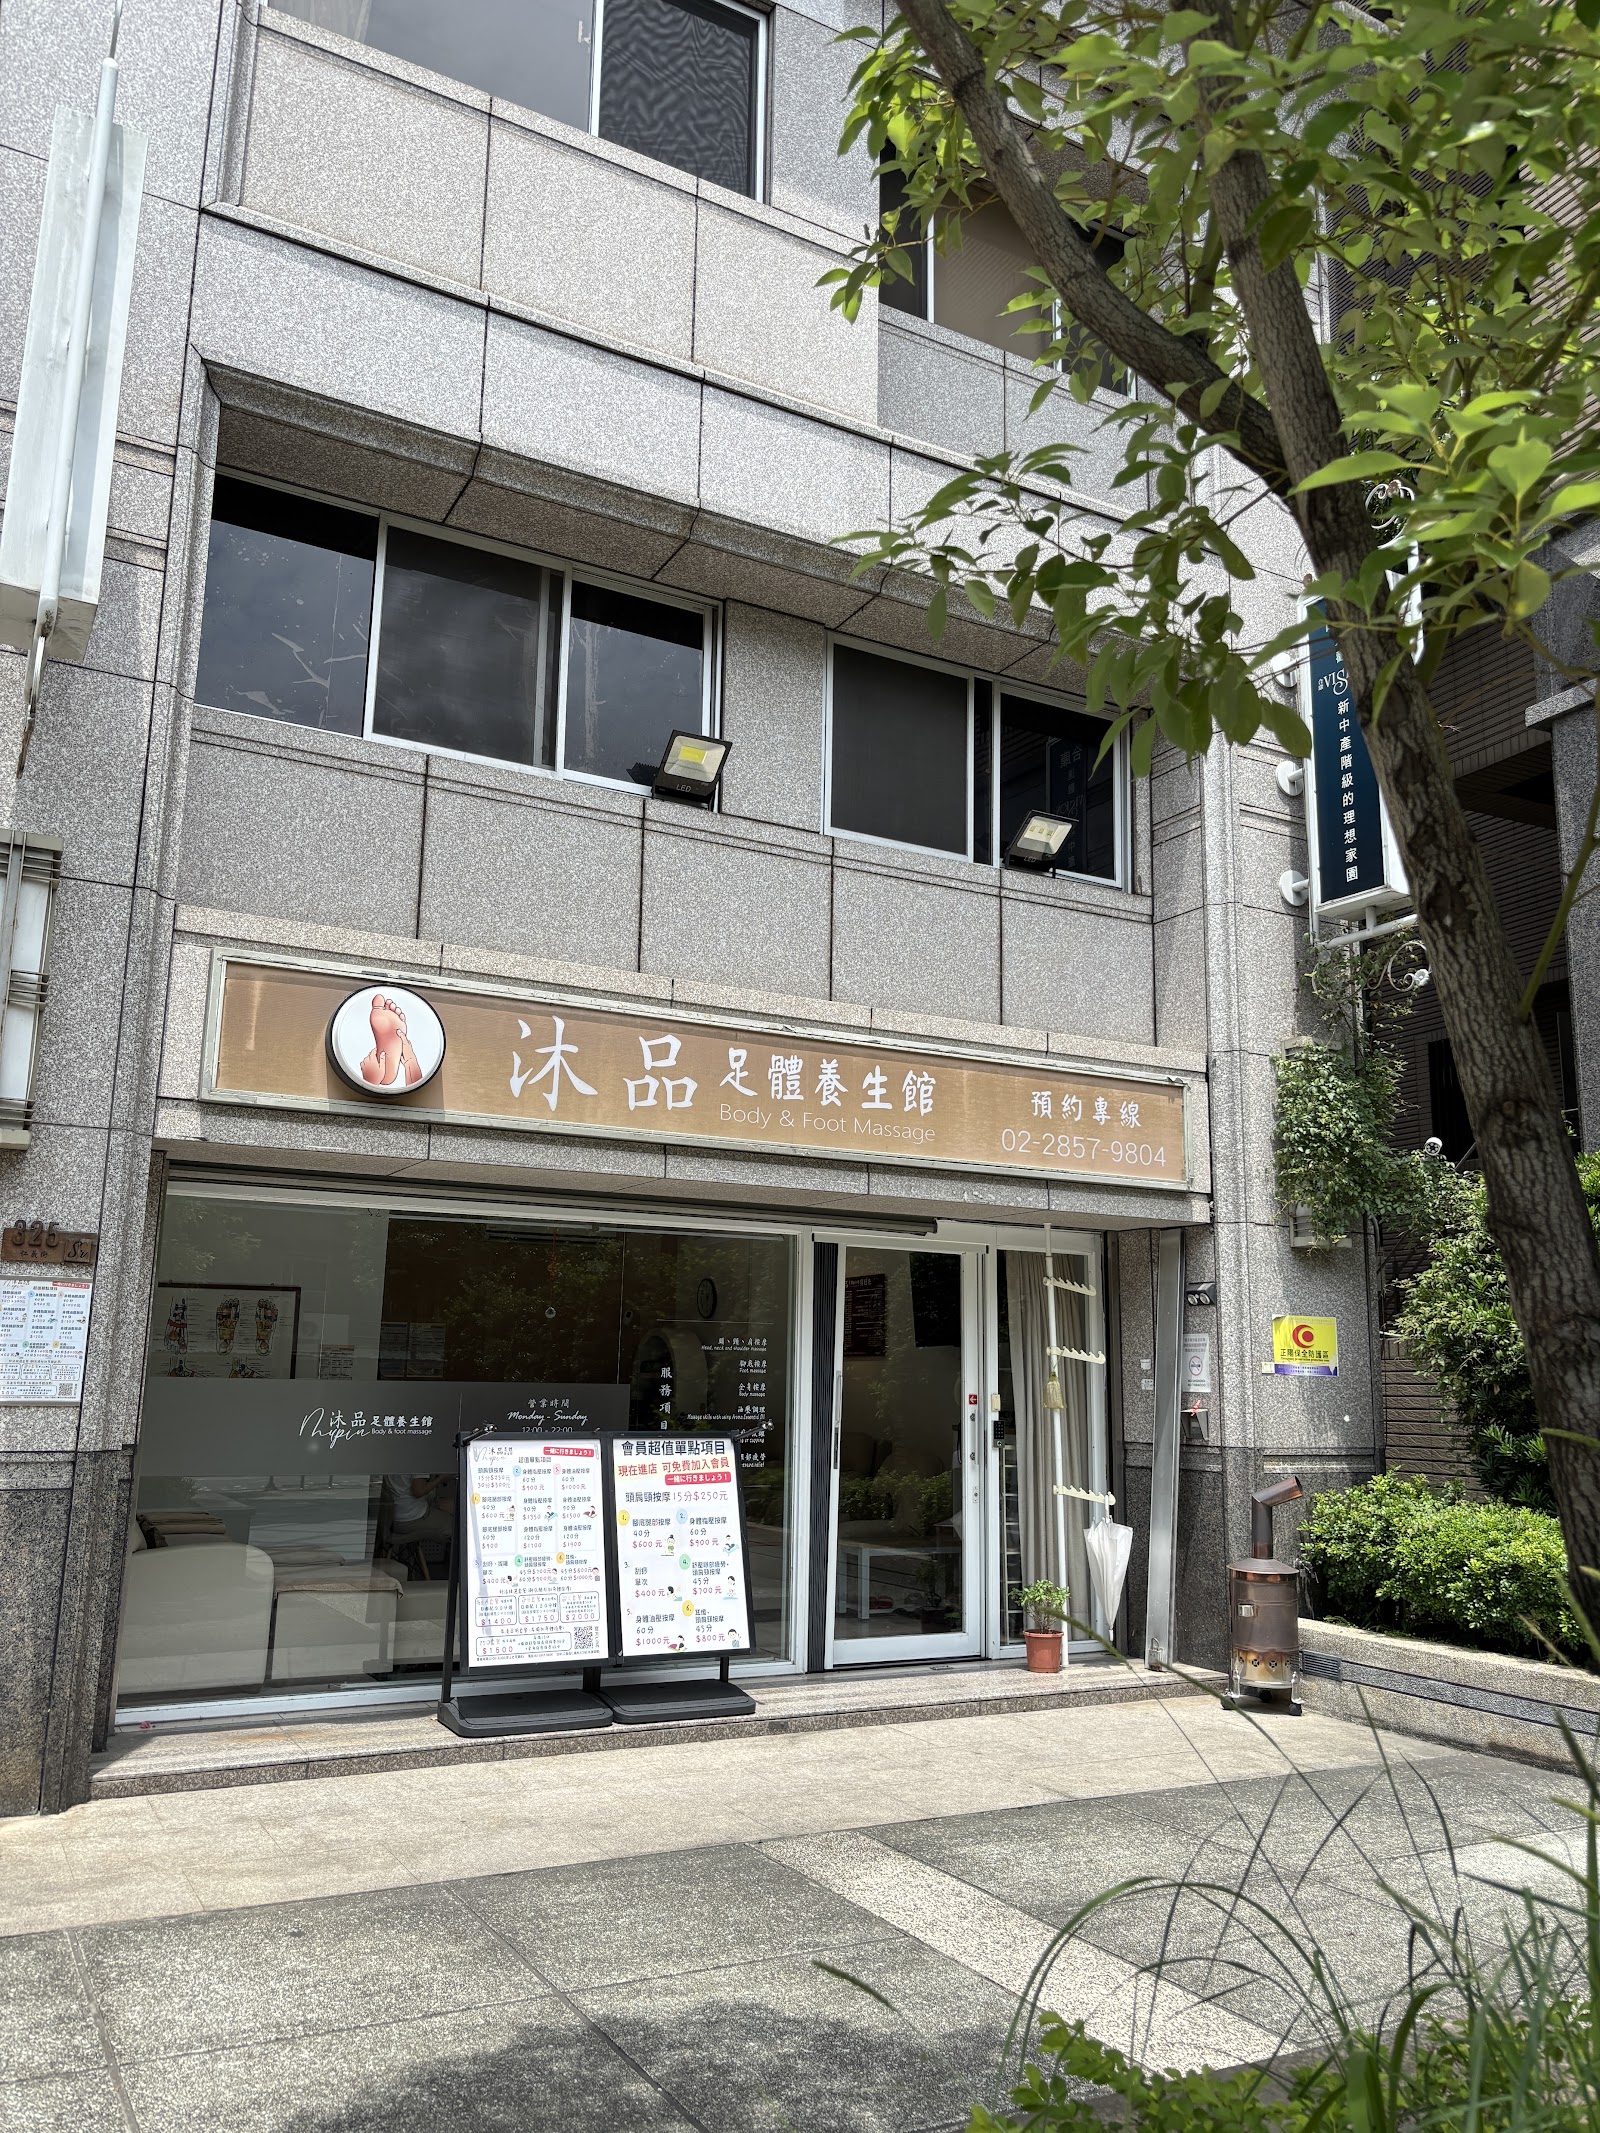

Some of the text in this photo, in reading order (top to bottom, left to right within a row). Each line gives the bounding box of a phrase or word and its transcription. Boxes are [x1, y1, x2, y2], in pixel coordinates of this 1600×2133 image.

[676, 784, 692, 792] LED
[1336, 698, 1359, 882] 新中產階級的理想家園
[508, 1015, 937, 1118] 沐品 足體養生館
[1030, 1090, 1142, 1130] 預約專線
[720, 1104, 936, 1144] Body & Foot Massage
[1000, 1128, 1167, 1168] 02-2857-9804
[12, 1220, 60, 1247] 325
[1280, 1349, 1328, 1358] 正陽保全防護區
[527, 1398, 570, 1408] 營業時間
[659, 1367, 672, 1430] 服務項目
[330, 1410, 433, 1427] 沐品 足體養生館
[508, 1410, 545, 1426] Monday
[554, 1410, 588, 1426] Sunday
[622, 1440, 725, 1456] 會員超值單點項目
[618, 1463, 657, 1477] 現在進店
[662, 1456, 730, 1473] 可免費加入會員
[693, 1577, 709, 1585] 45分
[636, 1626, 654, 1634] 60分
[696, 1624, 712, 1632] 45分
